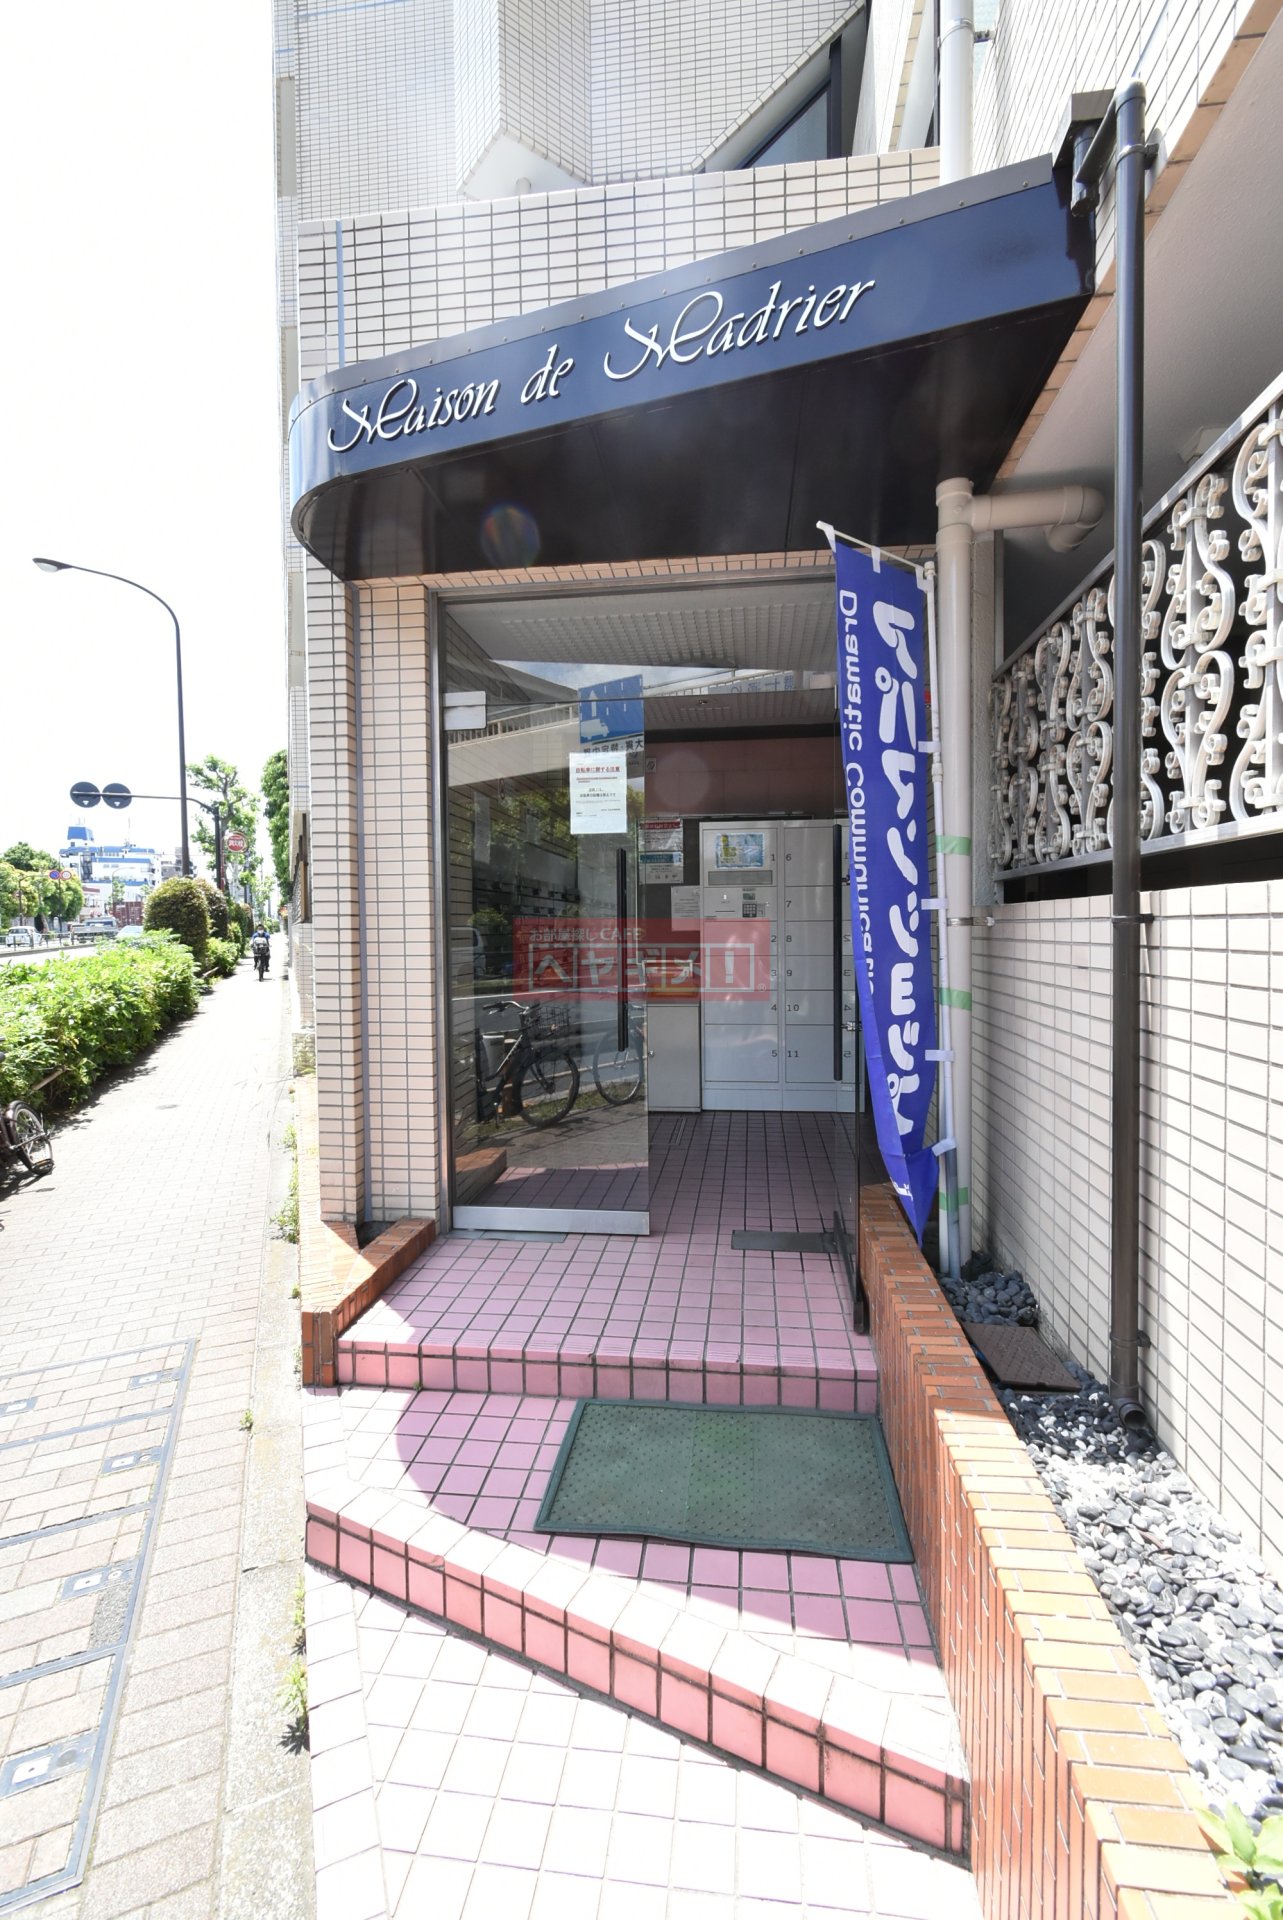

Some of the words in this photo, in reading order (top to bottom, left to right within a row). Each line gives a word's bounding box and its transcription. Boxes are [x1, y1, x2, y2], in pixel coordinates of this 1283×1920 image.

[327, 379, 502, 452] Maison
[520, 344, 575, 404] de
[603, 278, 875, 380] Madrier
[770, 853, 775, 861] 1
[785, 853, 792, 861] 6
[785, 900, 792, 908] 7
[770, 934, 777, 943] 2
[785, 934, 793, 943] 8
[771, 969, 777, 977] 3
[786, 969, 793, 977] 9
[770, 1004, 778, 1012] 4
[786, 1004, 800, 1012] 10
[771, 1049, 778, 1057] 5
[786, 1050, 800, 1058] 11
